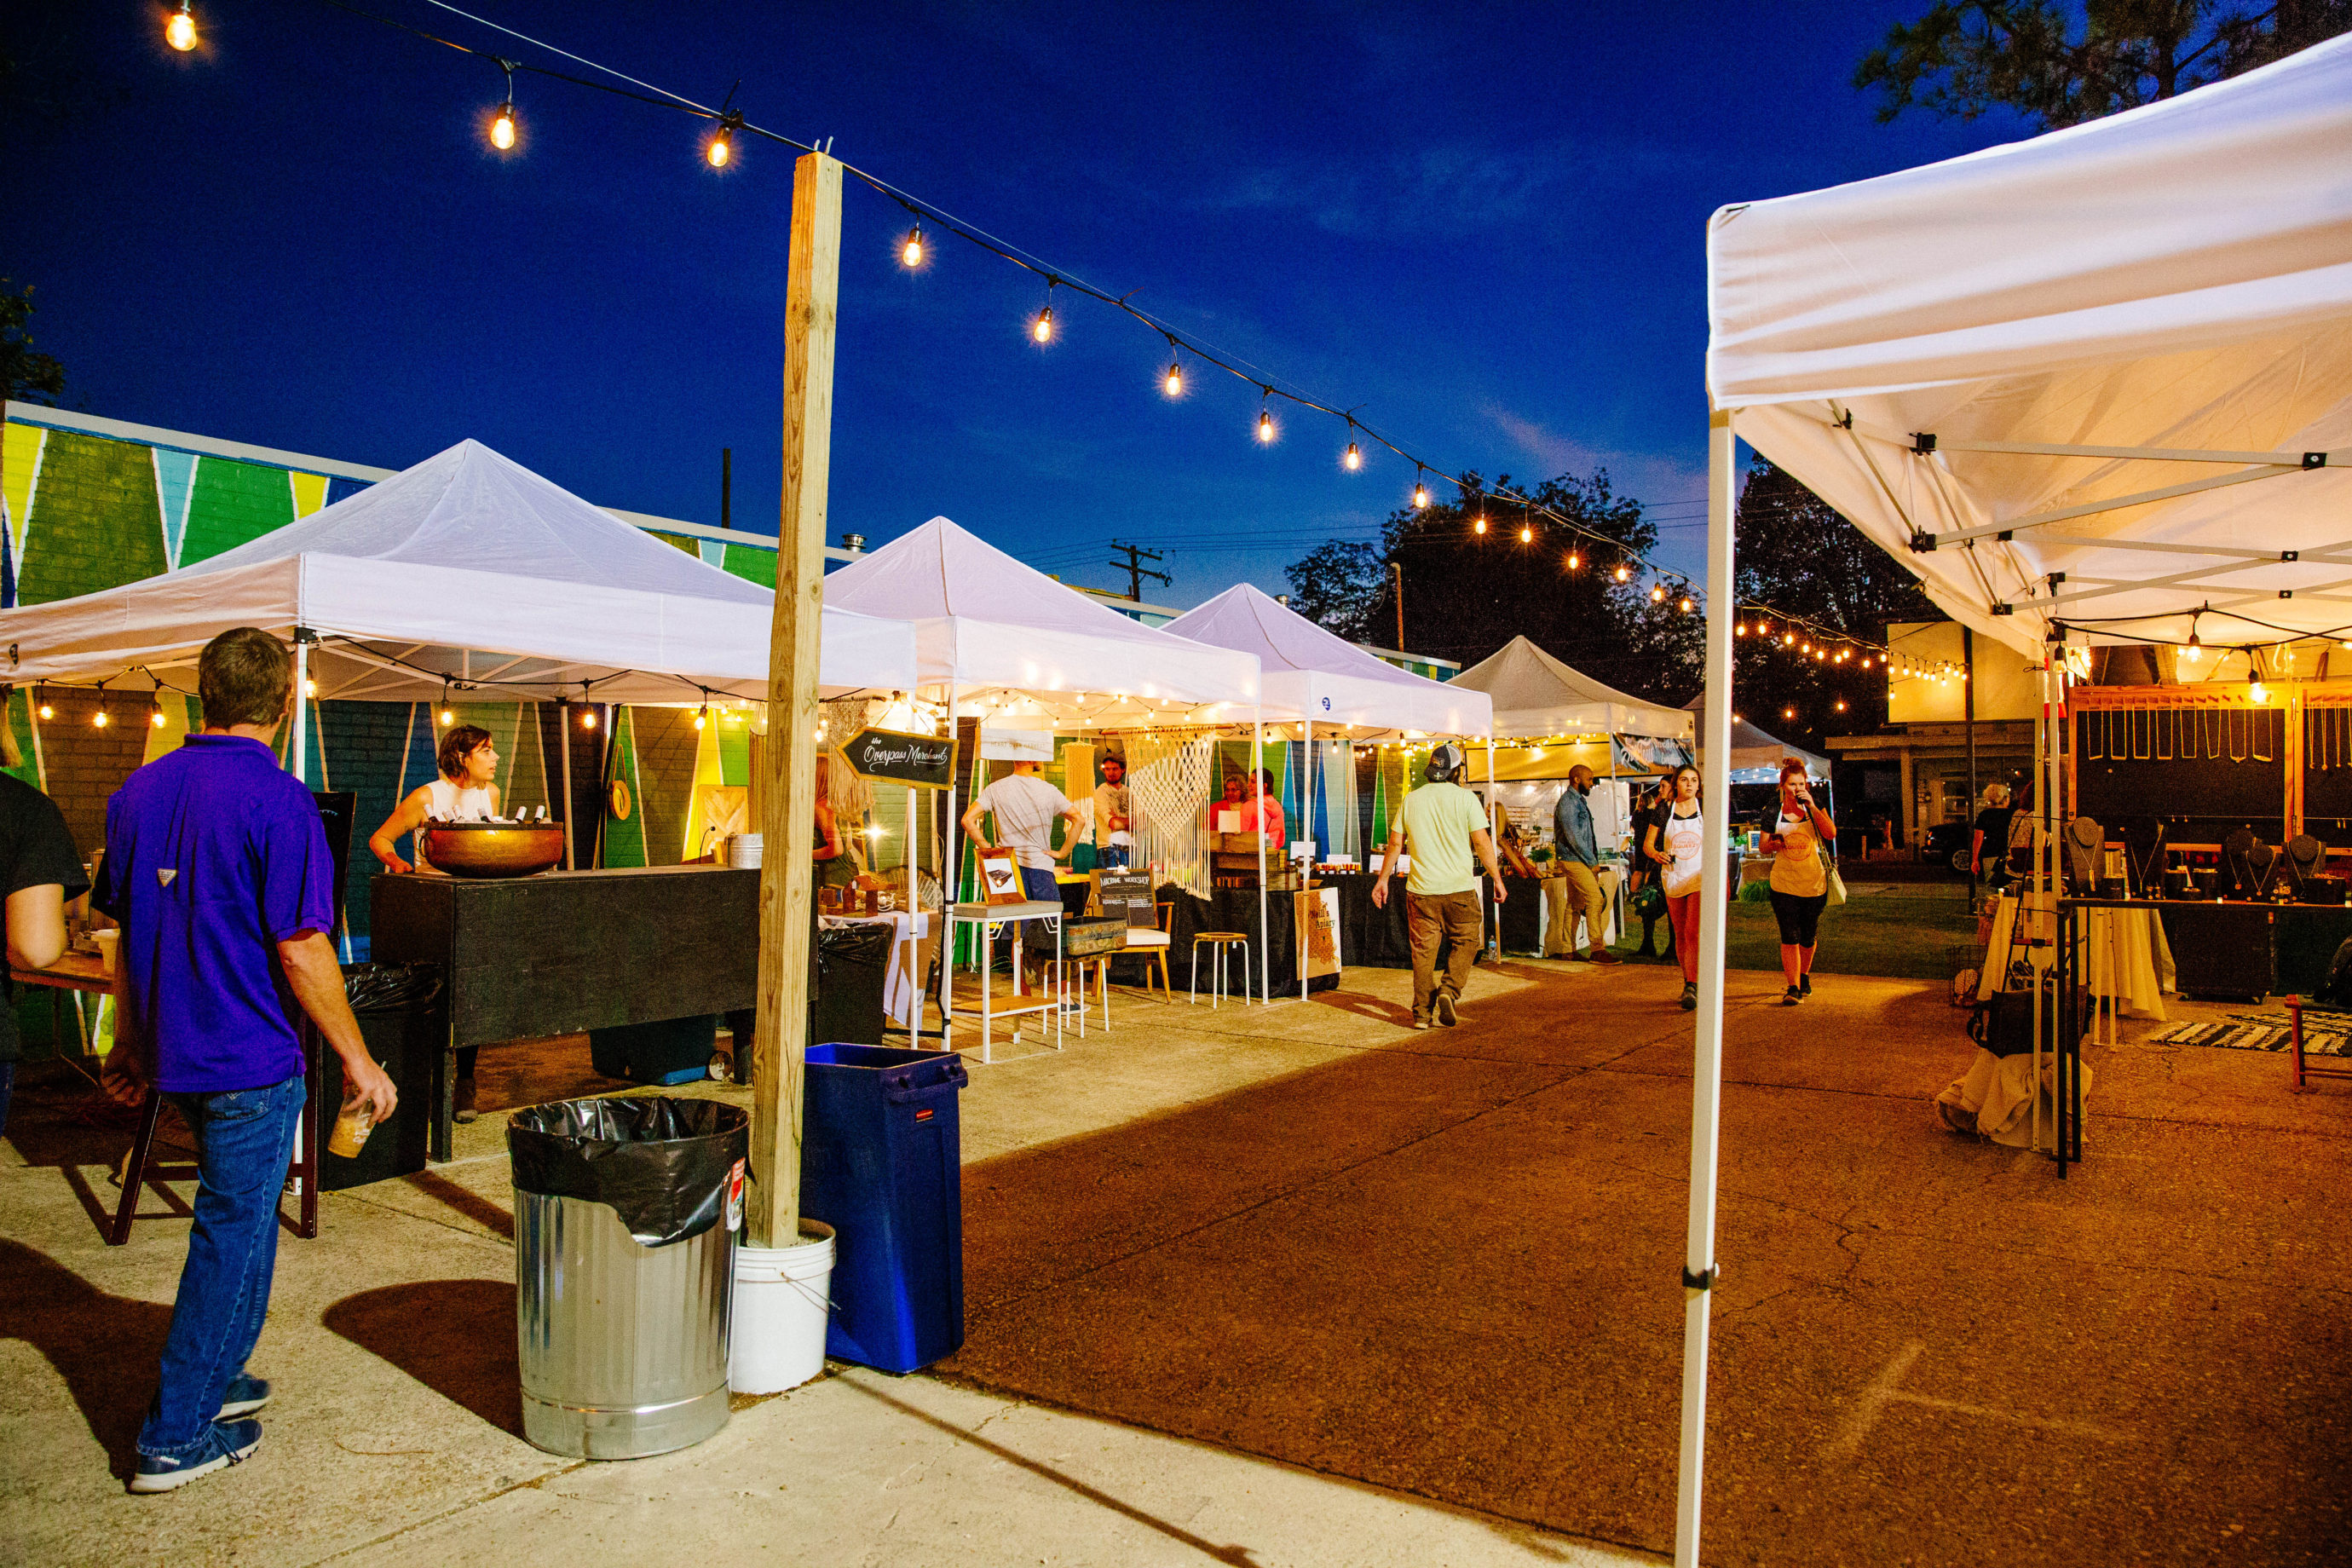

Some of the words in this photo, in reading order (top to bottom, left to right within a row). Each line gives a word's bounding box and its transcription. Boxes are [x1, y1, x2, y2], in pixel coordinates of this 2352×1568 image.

[863, 745, 907, 767] Overpass
[905, 744, 948, 766] Merchant
[1124, 876, 1150, 885] WORKSHOP
[1315, 919, 1335, 930] Apiary
